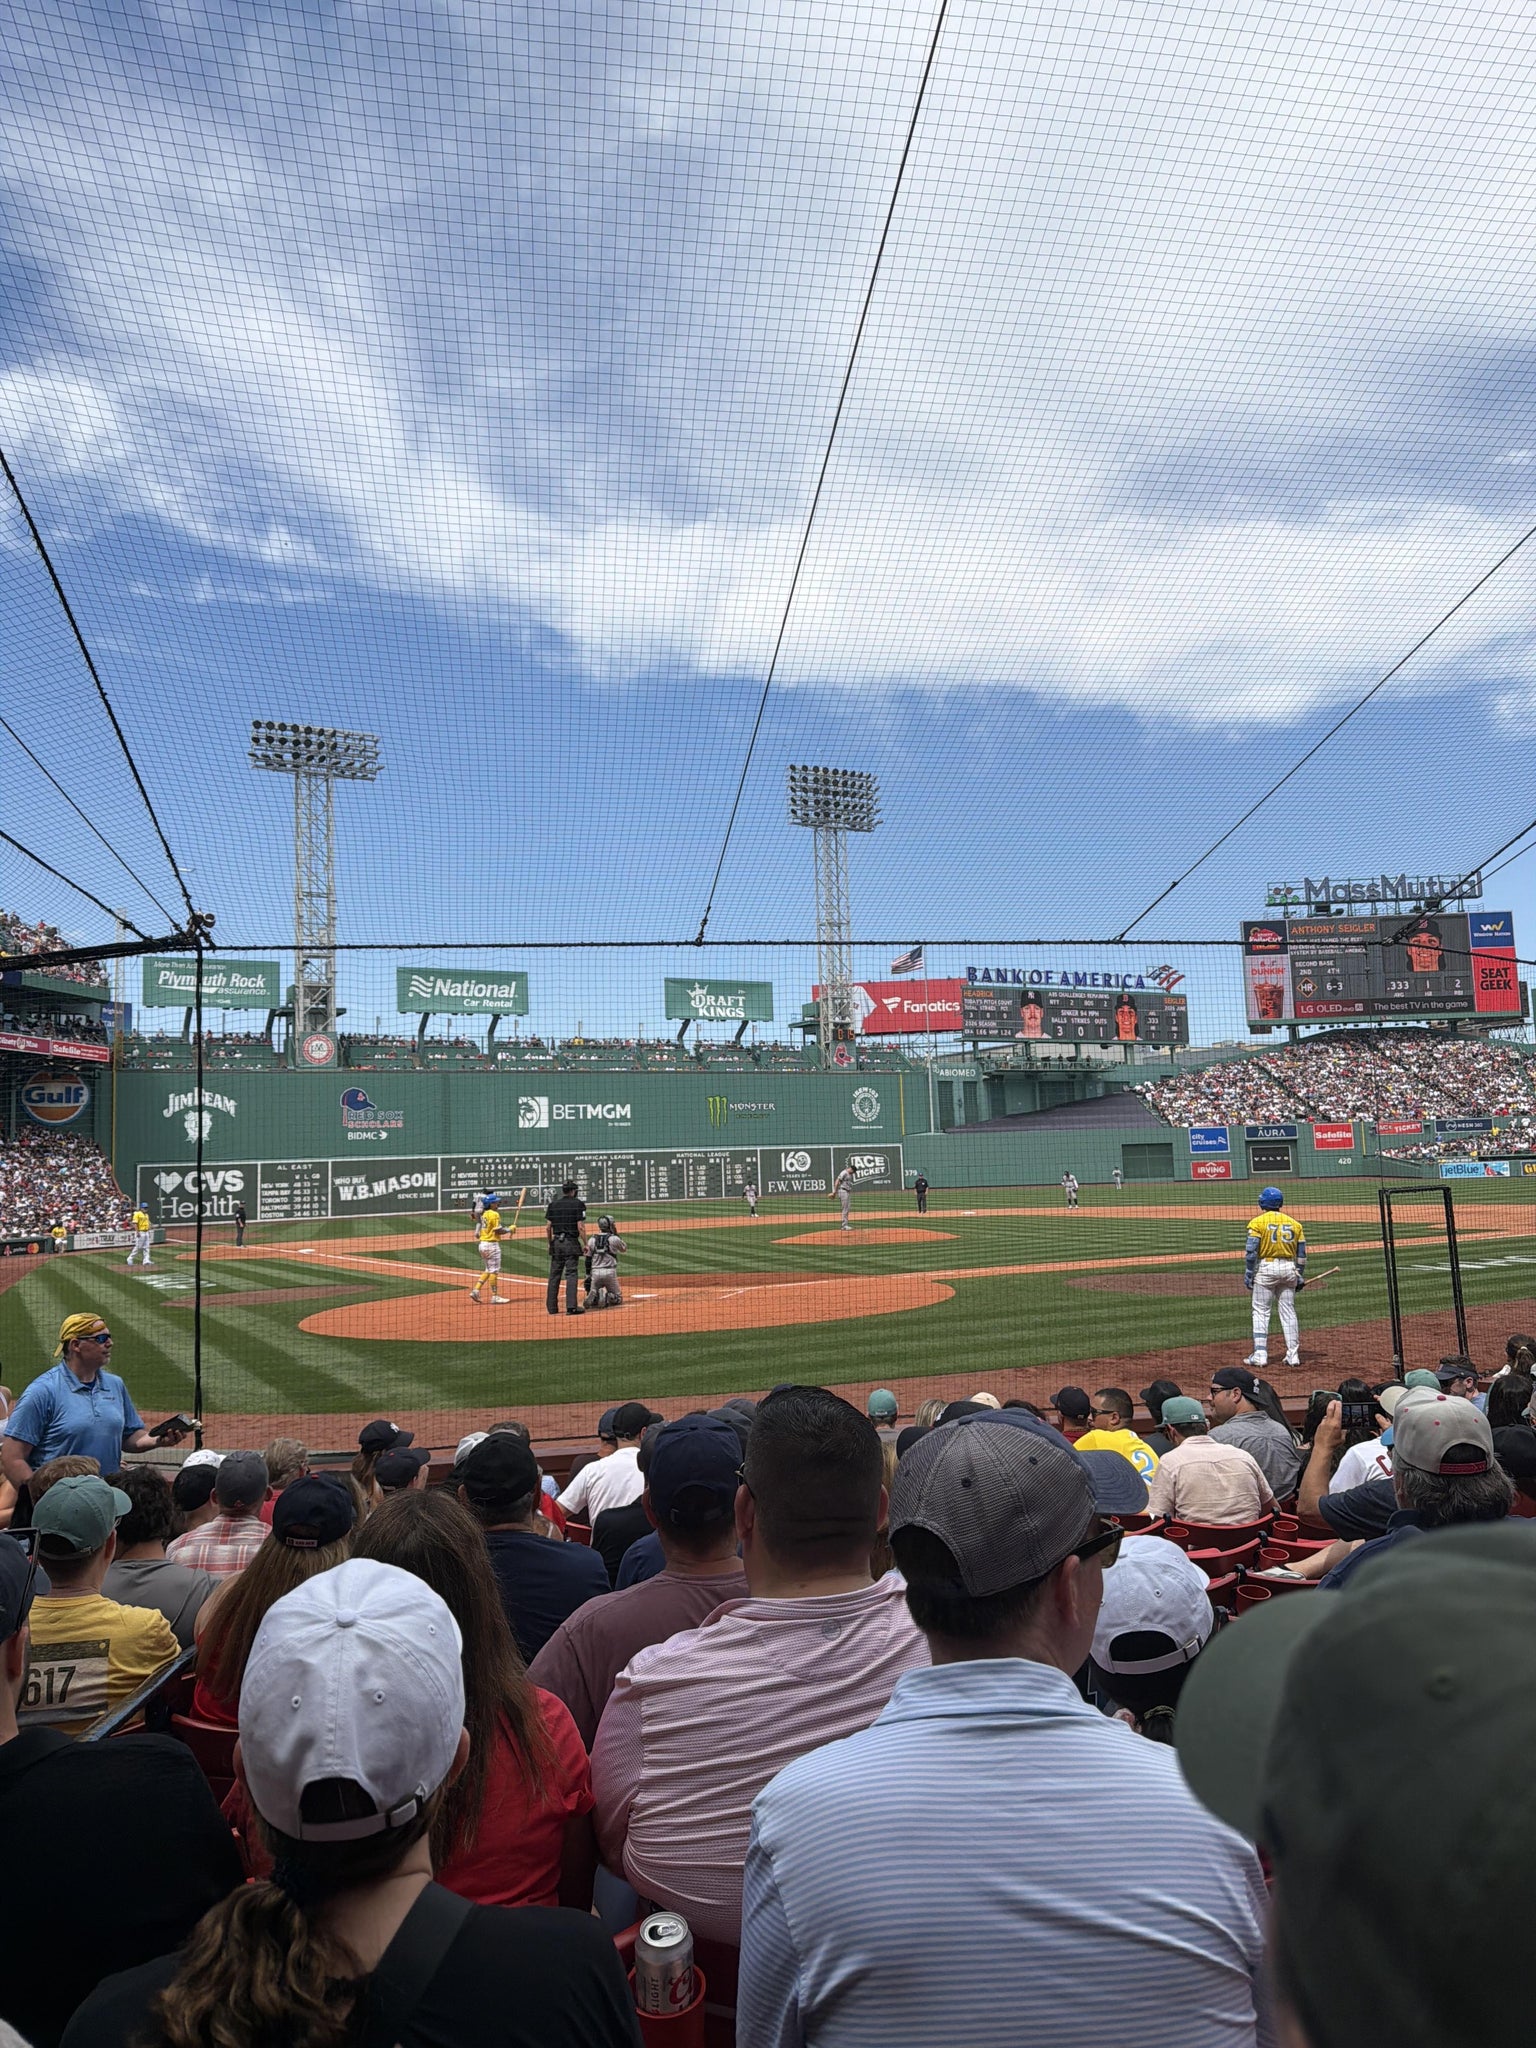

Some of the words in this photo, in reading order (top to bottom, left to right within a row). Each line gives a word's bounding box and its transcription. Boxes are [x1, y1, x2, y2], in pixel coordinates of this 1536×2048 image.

[1304, 871, 1483, 902] MassMutual
[1291, 924, 1334, 934] ANTHONY
[1338, 923, 1376, 933] SEIGLER
[158, 970, 226, 987] Plymuth
[230, 973, 266, 988] Rock
[966, 966, 1022, 984] BANK
[1029, 969, 1053, 985] OF
[1060, 971, 1145, 989] AMERICA
[1481, 968, 1510, 979] SEAT
[434, 978, 516, 998] National
[1301, 983, 1313, 991] HR
[1327, 982, 1343, 991] 6-3
[1387, 981, 1409, 990] .333
[1455, 979, 1460, 988] 2
[1480, 980, 1512, 990] GEEK
[463, 999, 480, 1007] Car
[482, 999, 513, 1008] Rental
[691, 994, 746, 1008] DRAFT
[904, 999, 960, 1013] Fanatics
[698, 1005, 745, 1018] KINGS
[1316, 1004, 1342, 1012] OLED
[1057, 1026, 1063, 1036] 3
[1078, 1026, 1084, 1037] 0
[53, 1045, 81, 1055] Safelite
[939, 1069, 976, 1077] ABIOMED
[24, 1086, 84, 1104] Gulf
[163, 1092, 193, 1118] JIM
[194, 1086, 238, 1118] BEAM
[729, 1102, 776, 1111] MONSTER
[348, 1111, 374, 1120] RED
[378, 1111, 403, 1120] SOX
[553, 1104, 631, 1120] BETMGM
[348, 1120, 403, 1128] SCHOLARS
[1395, 1124, 1421, 1133] TICKET
[348, 1132, 377, 1140] BIDMC
[853, 1156, 885, 1167] ACE
[856, 1167, 885, 1178] TICKET
[1445, 1164, 1479, 1176] jetBlue
[184, 1170, 244, 1194] CVS
[334, 1177, 350, 1185] WHO
[768, 1181, 789, 1192] F.W.
[792, 1180, 826, 1191] WEBB
[156, 1195, 241, 1219] Health
[1267, 1224, 1295, 1243] 75
[24, 1666, 76, 1707] 617
[650, 1977, 659, 2010] LIGHT
